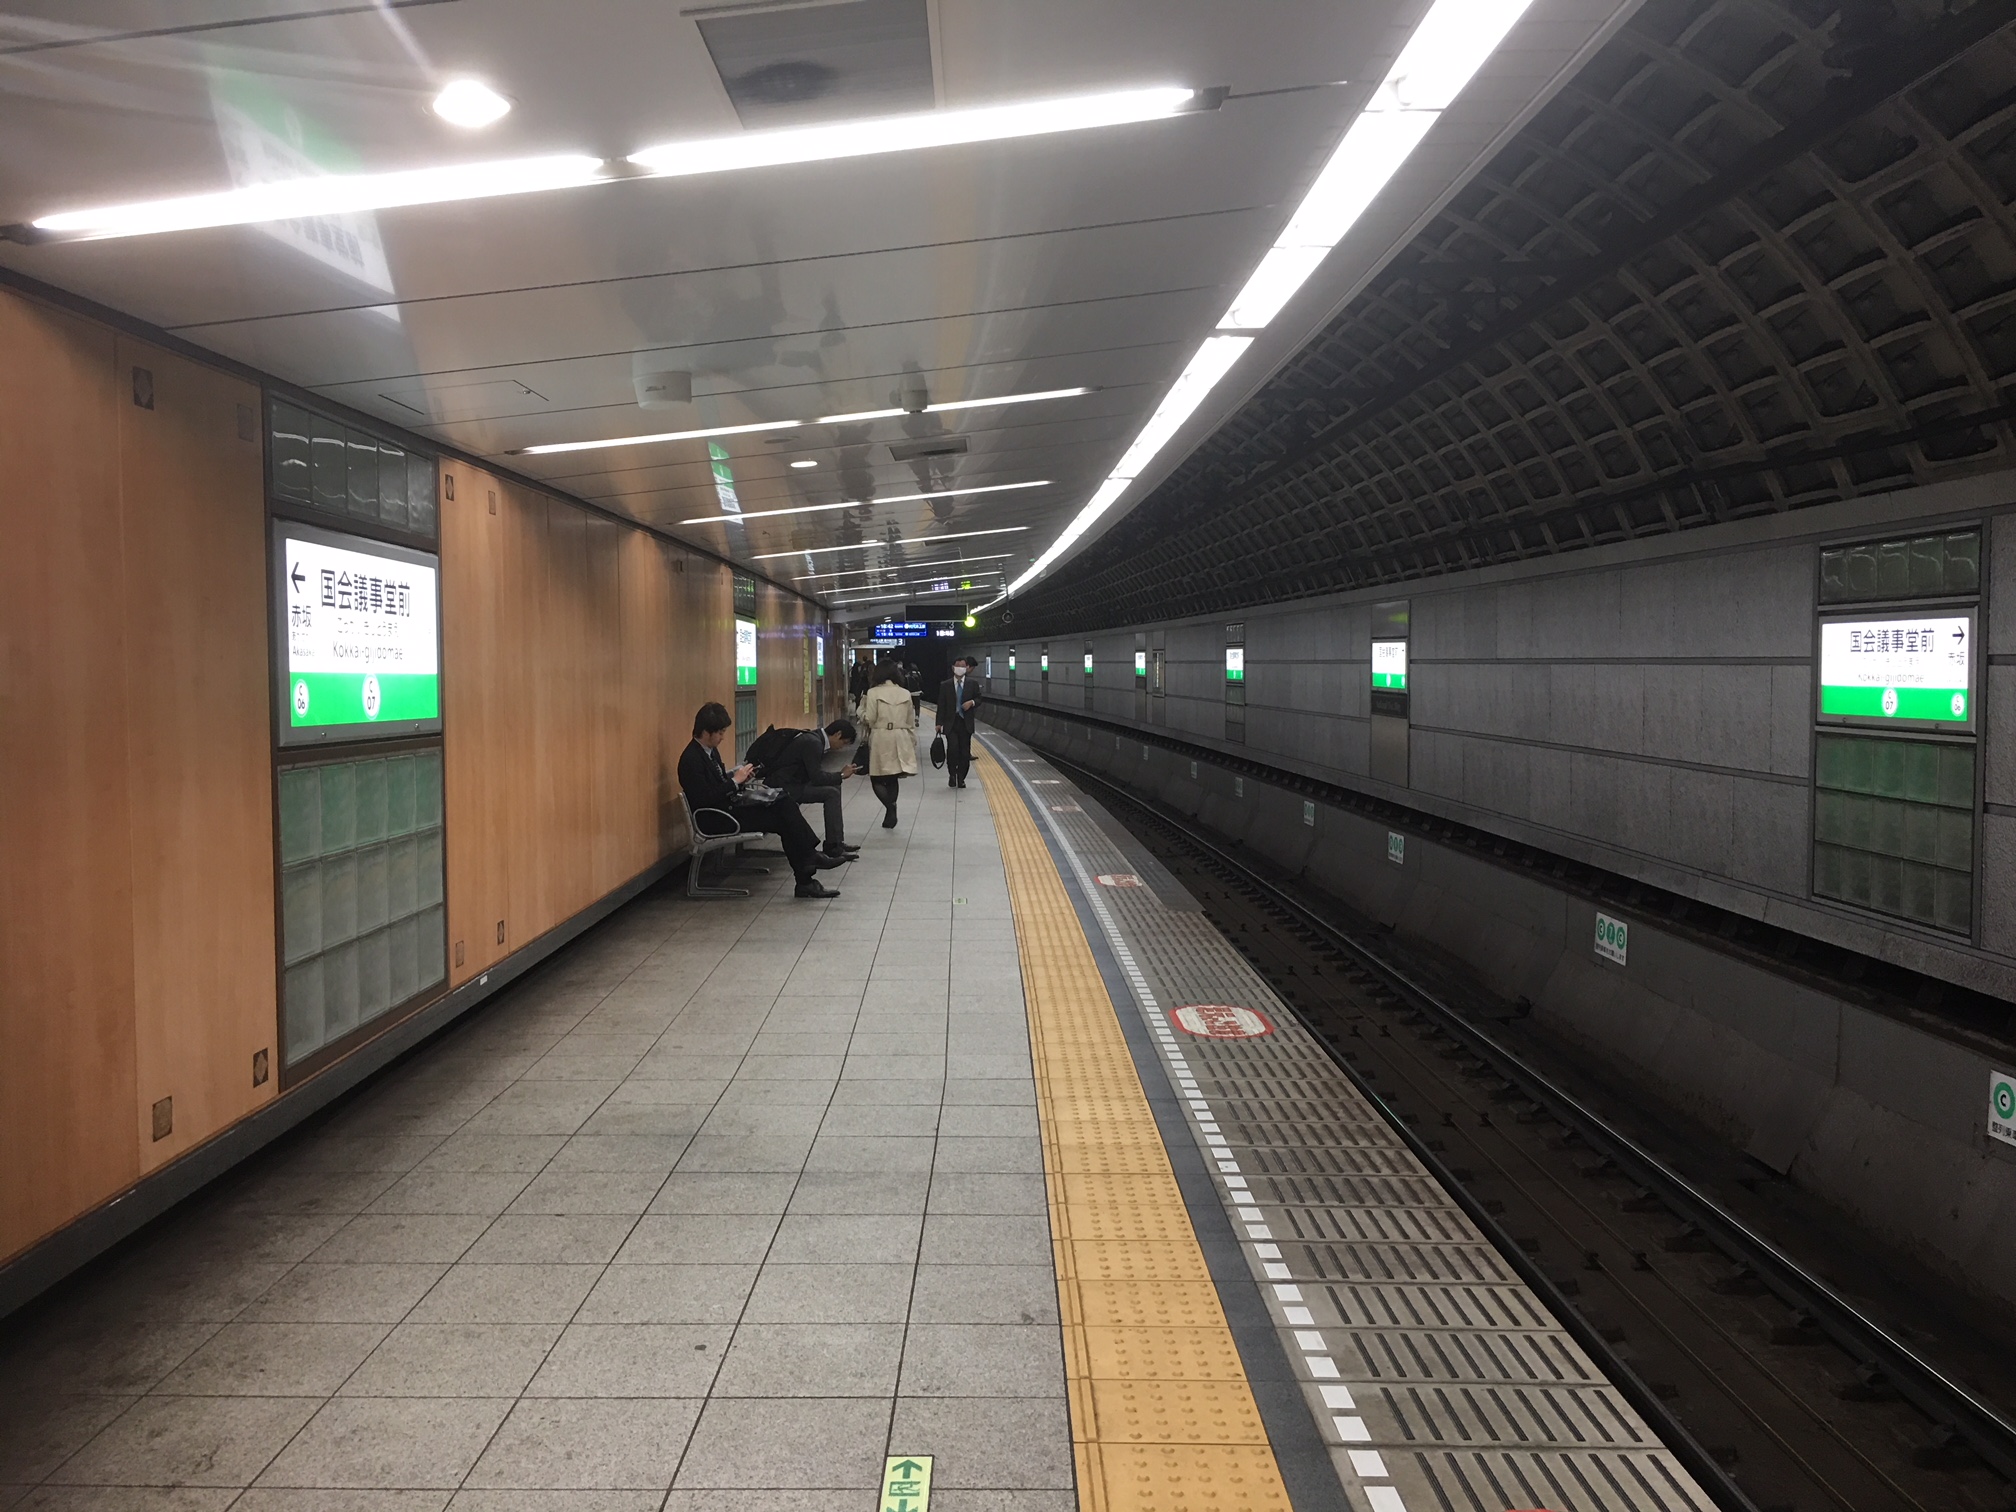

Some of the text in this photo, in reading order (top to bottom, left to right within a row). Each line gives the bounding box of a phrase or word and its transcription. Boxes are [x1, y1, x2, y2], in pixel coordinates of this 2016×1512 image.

[321, 569, 411, 617] 国会議事堂前
[291, 604, 312, 628] 赤坂
[1849, 627, 1935, 653] 国会議事堂前
[332, 640, 404, 664] Kokkai-gijidomae
[1858, 673, 1925, 685] Kokkai-gijidomae
[297, 696, 306, 710] 06
[366, 696, 376, 710] 07
[1885, 701, 1894, 711] 07
[2000, 1093, 2007, 1107] C
